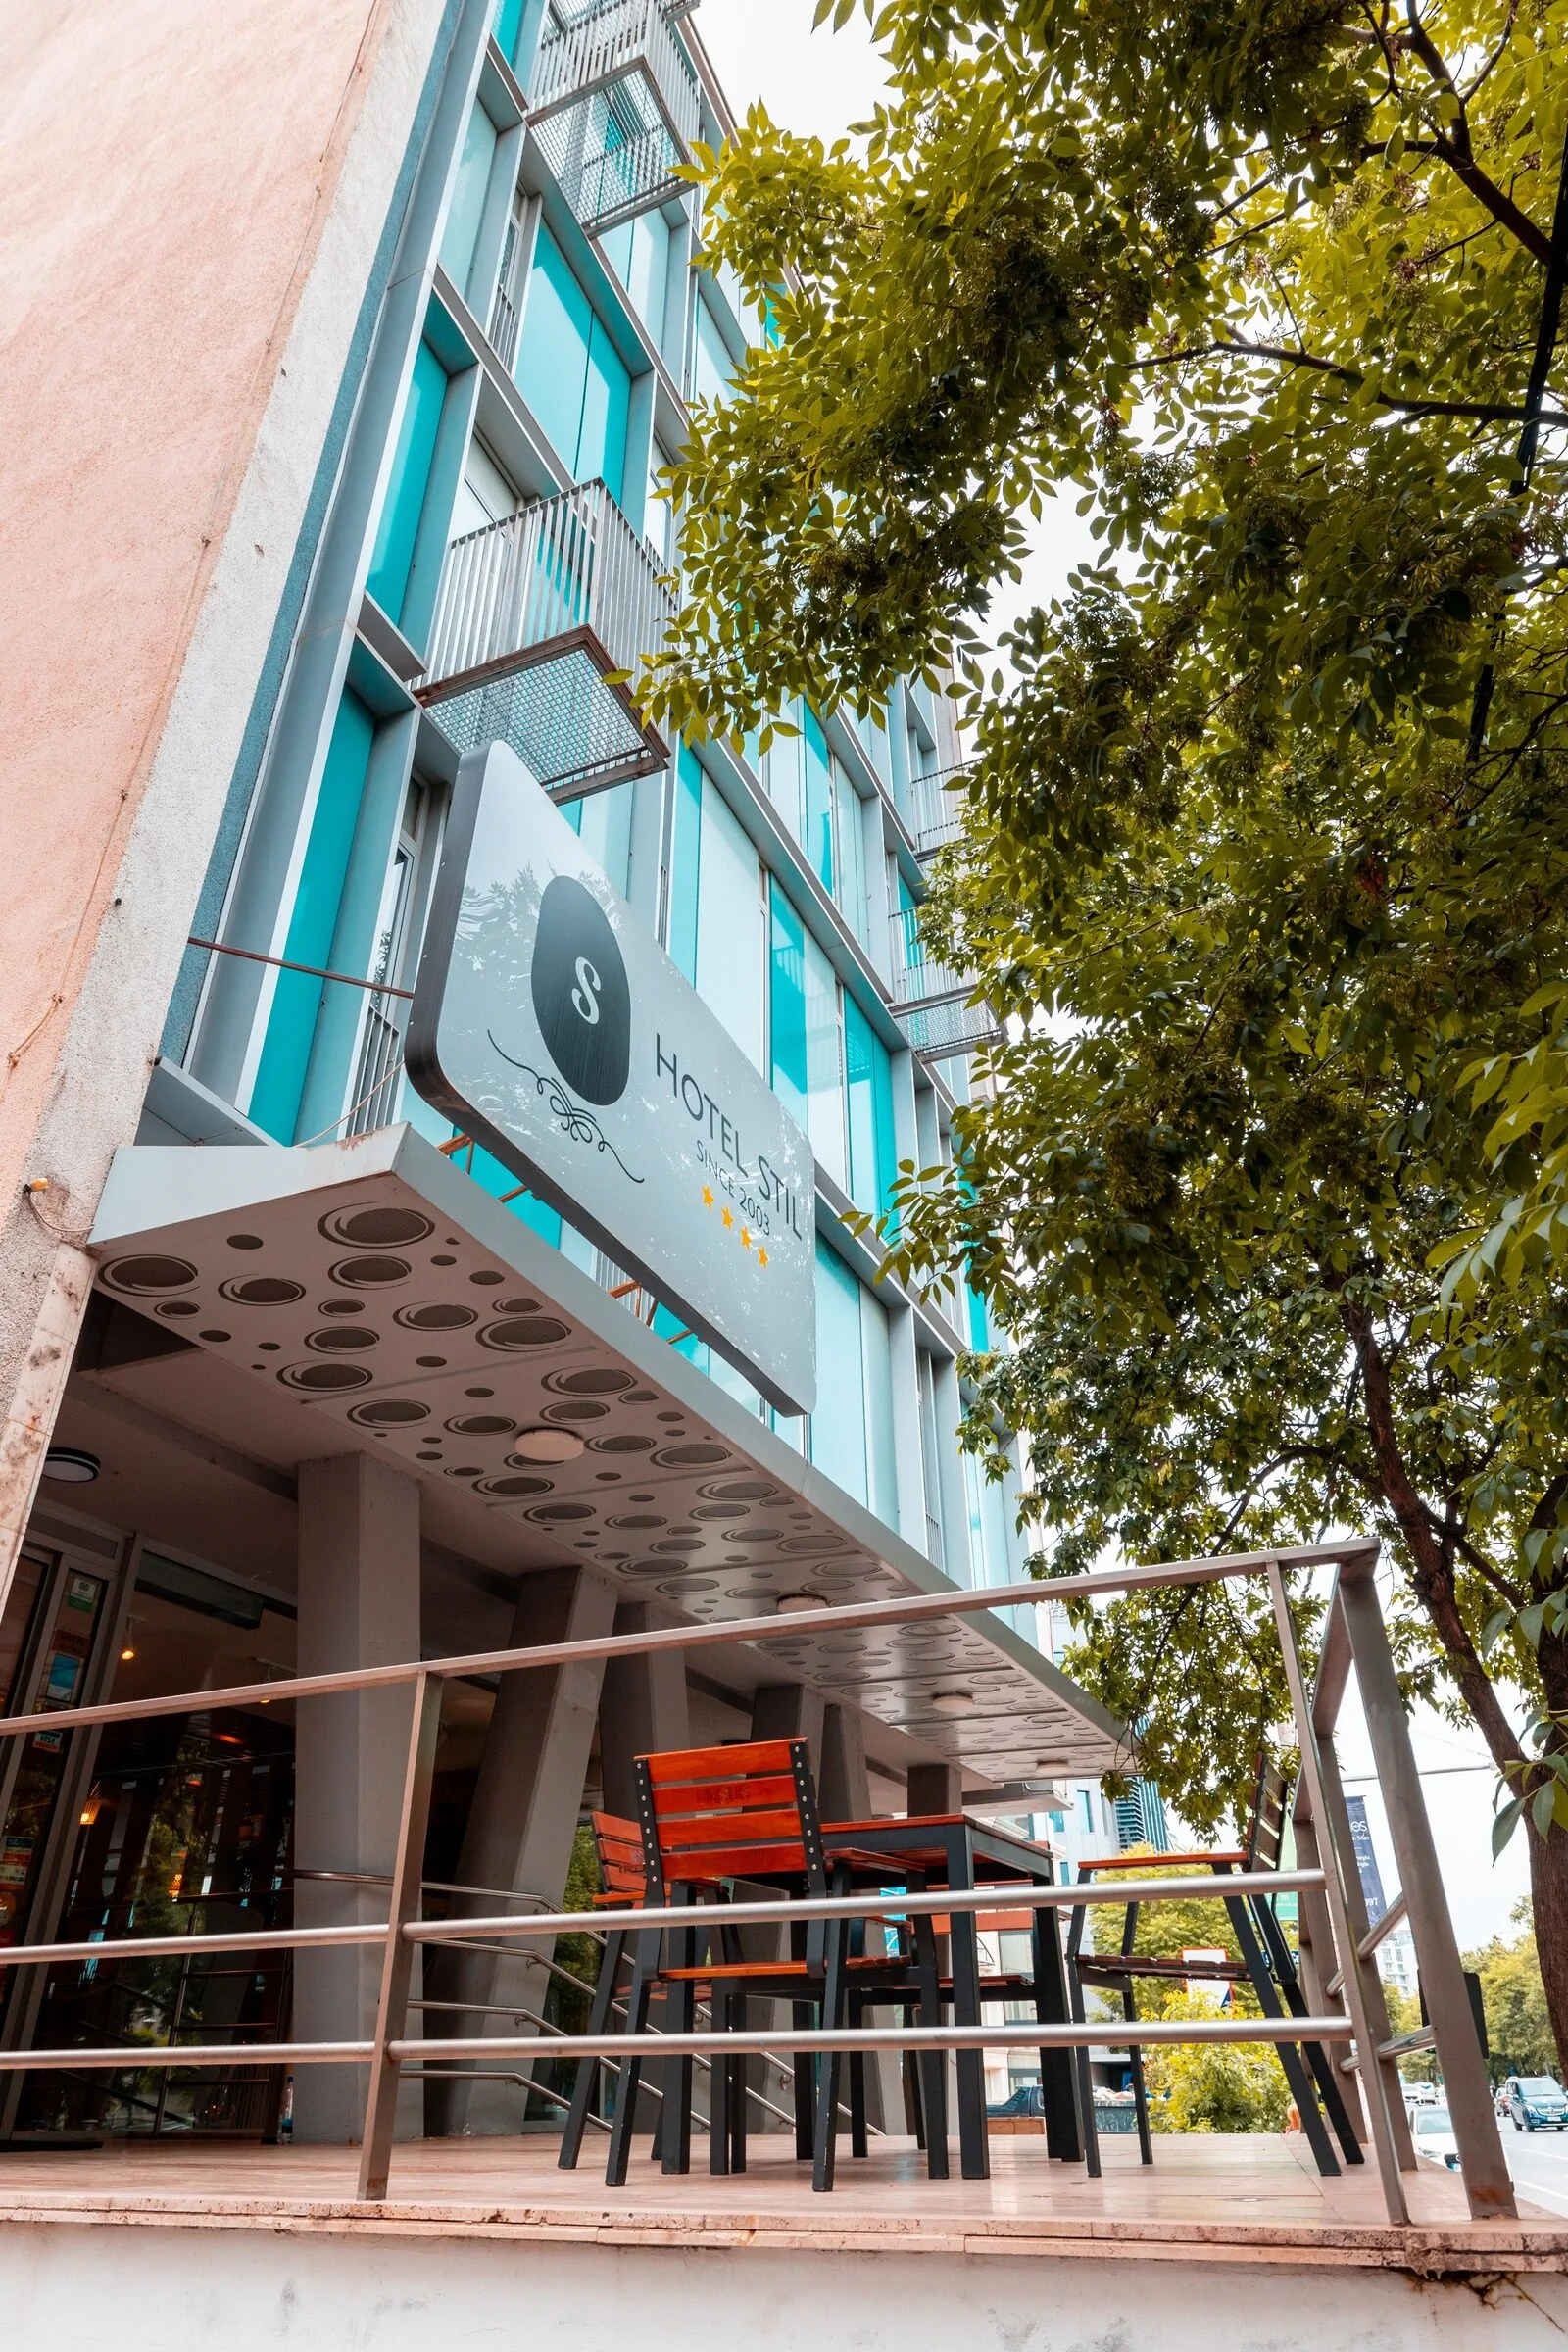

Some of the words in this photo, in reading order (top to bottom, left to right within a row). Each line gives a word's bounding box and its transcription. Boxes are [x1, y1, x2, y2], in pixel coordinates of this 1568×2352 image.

[570, 956, 601, 1024] S
[656, 1032, 748, 1178] HOTEL
[758, 1155, 802, 1241] STIL
[696, 1140, 735, 1199] SINCE
[739, 1187, 770, 1236] 2003
[40, 1734, 56, 1745] VISA
